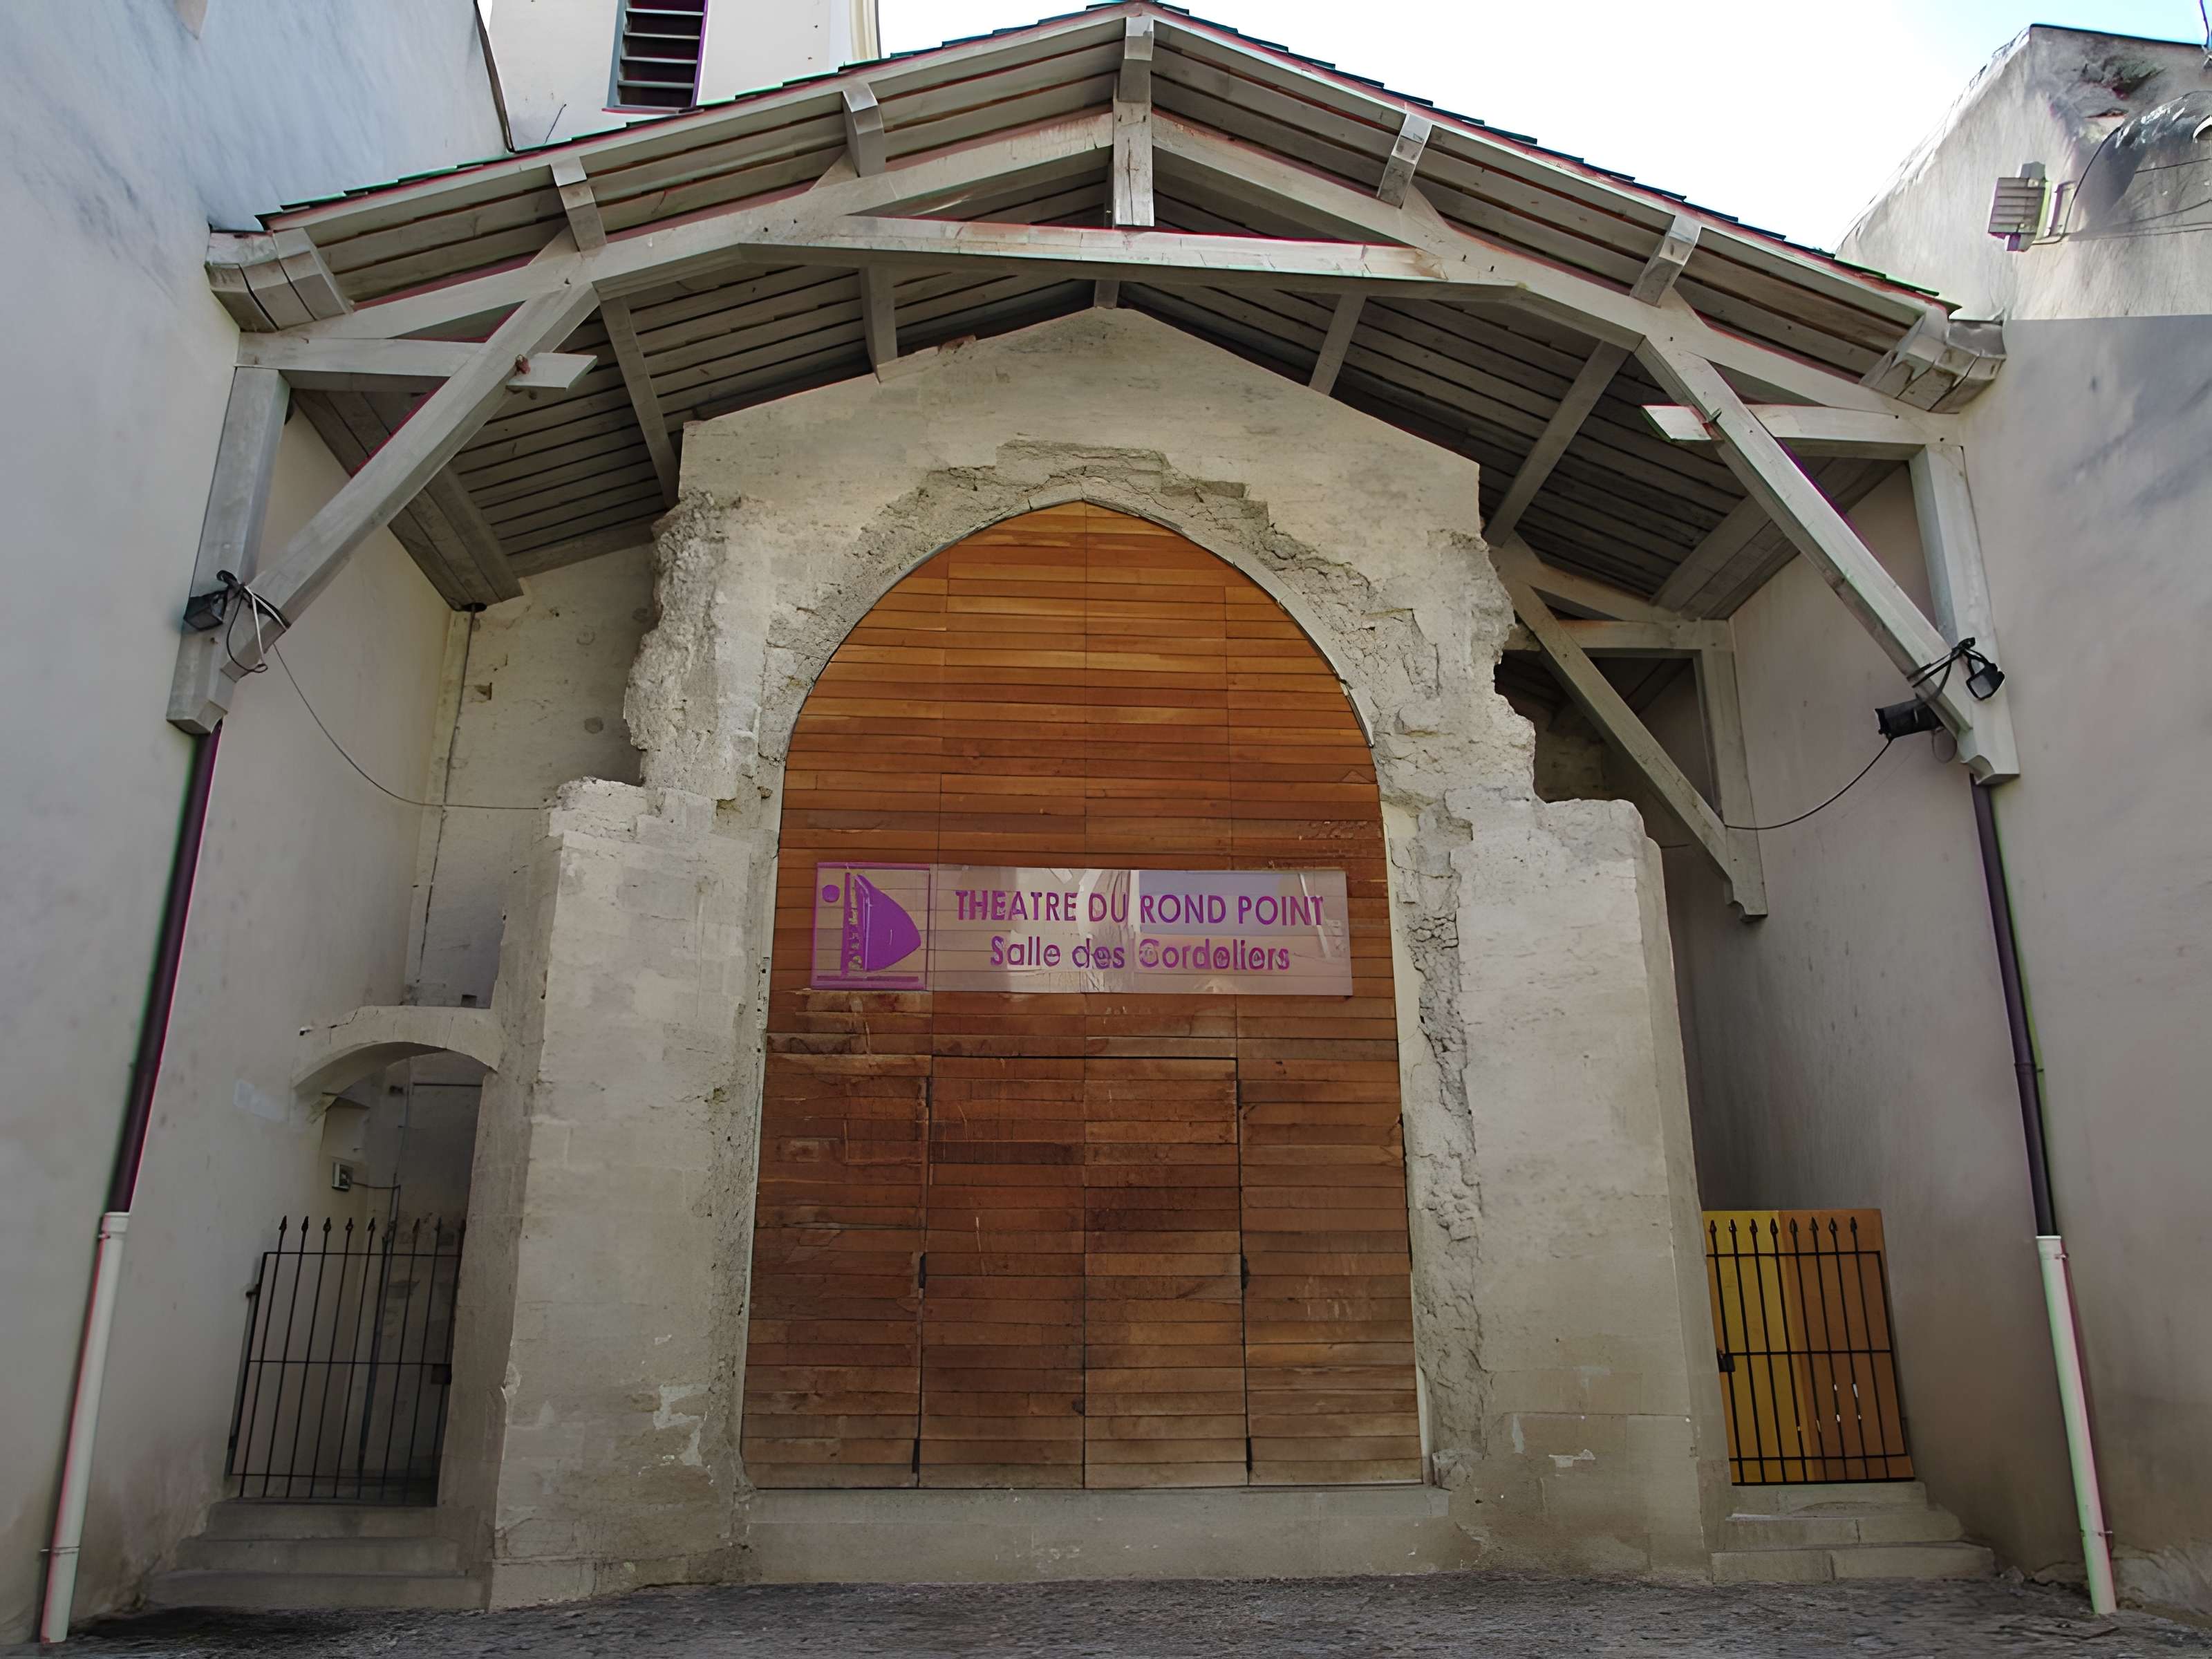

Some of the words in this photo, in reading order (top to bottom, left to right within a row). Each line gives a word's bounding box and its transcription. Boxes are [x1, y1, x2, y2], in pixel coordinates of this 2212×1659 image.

[955, 890, 1078, 921] THEATRE
[1088, 892, 1130, 923] DU
[1140, 894, 1226, 924] ROND
[1238, 895, 1324, 926] POINT
[991, 935, 1061, 967] Salle
[1072, 937, 1125, 970] des
